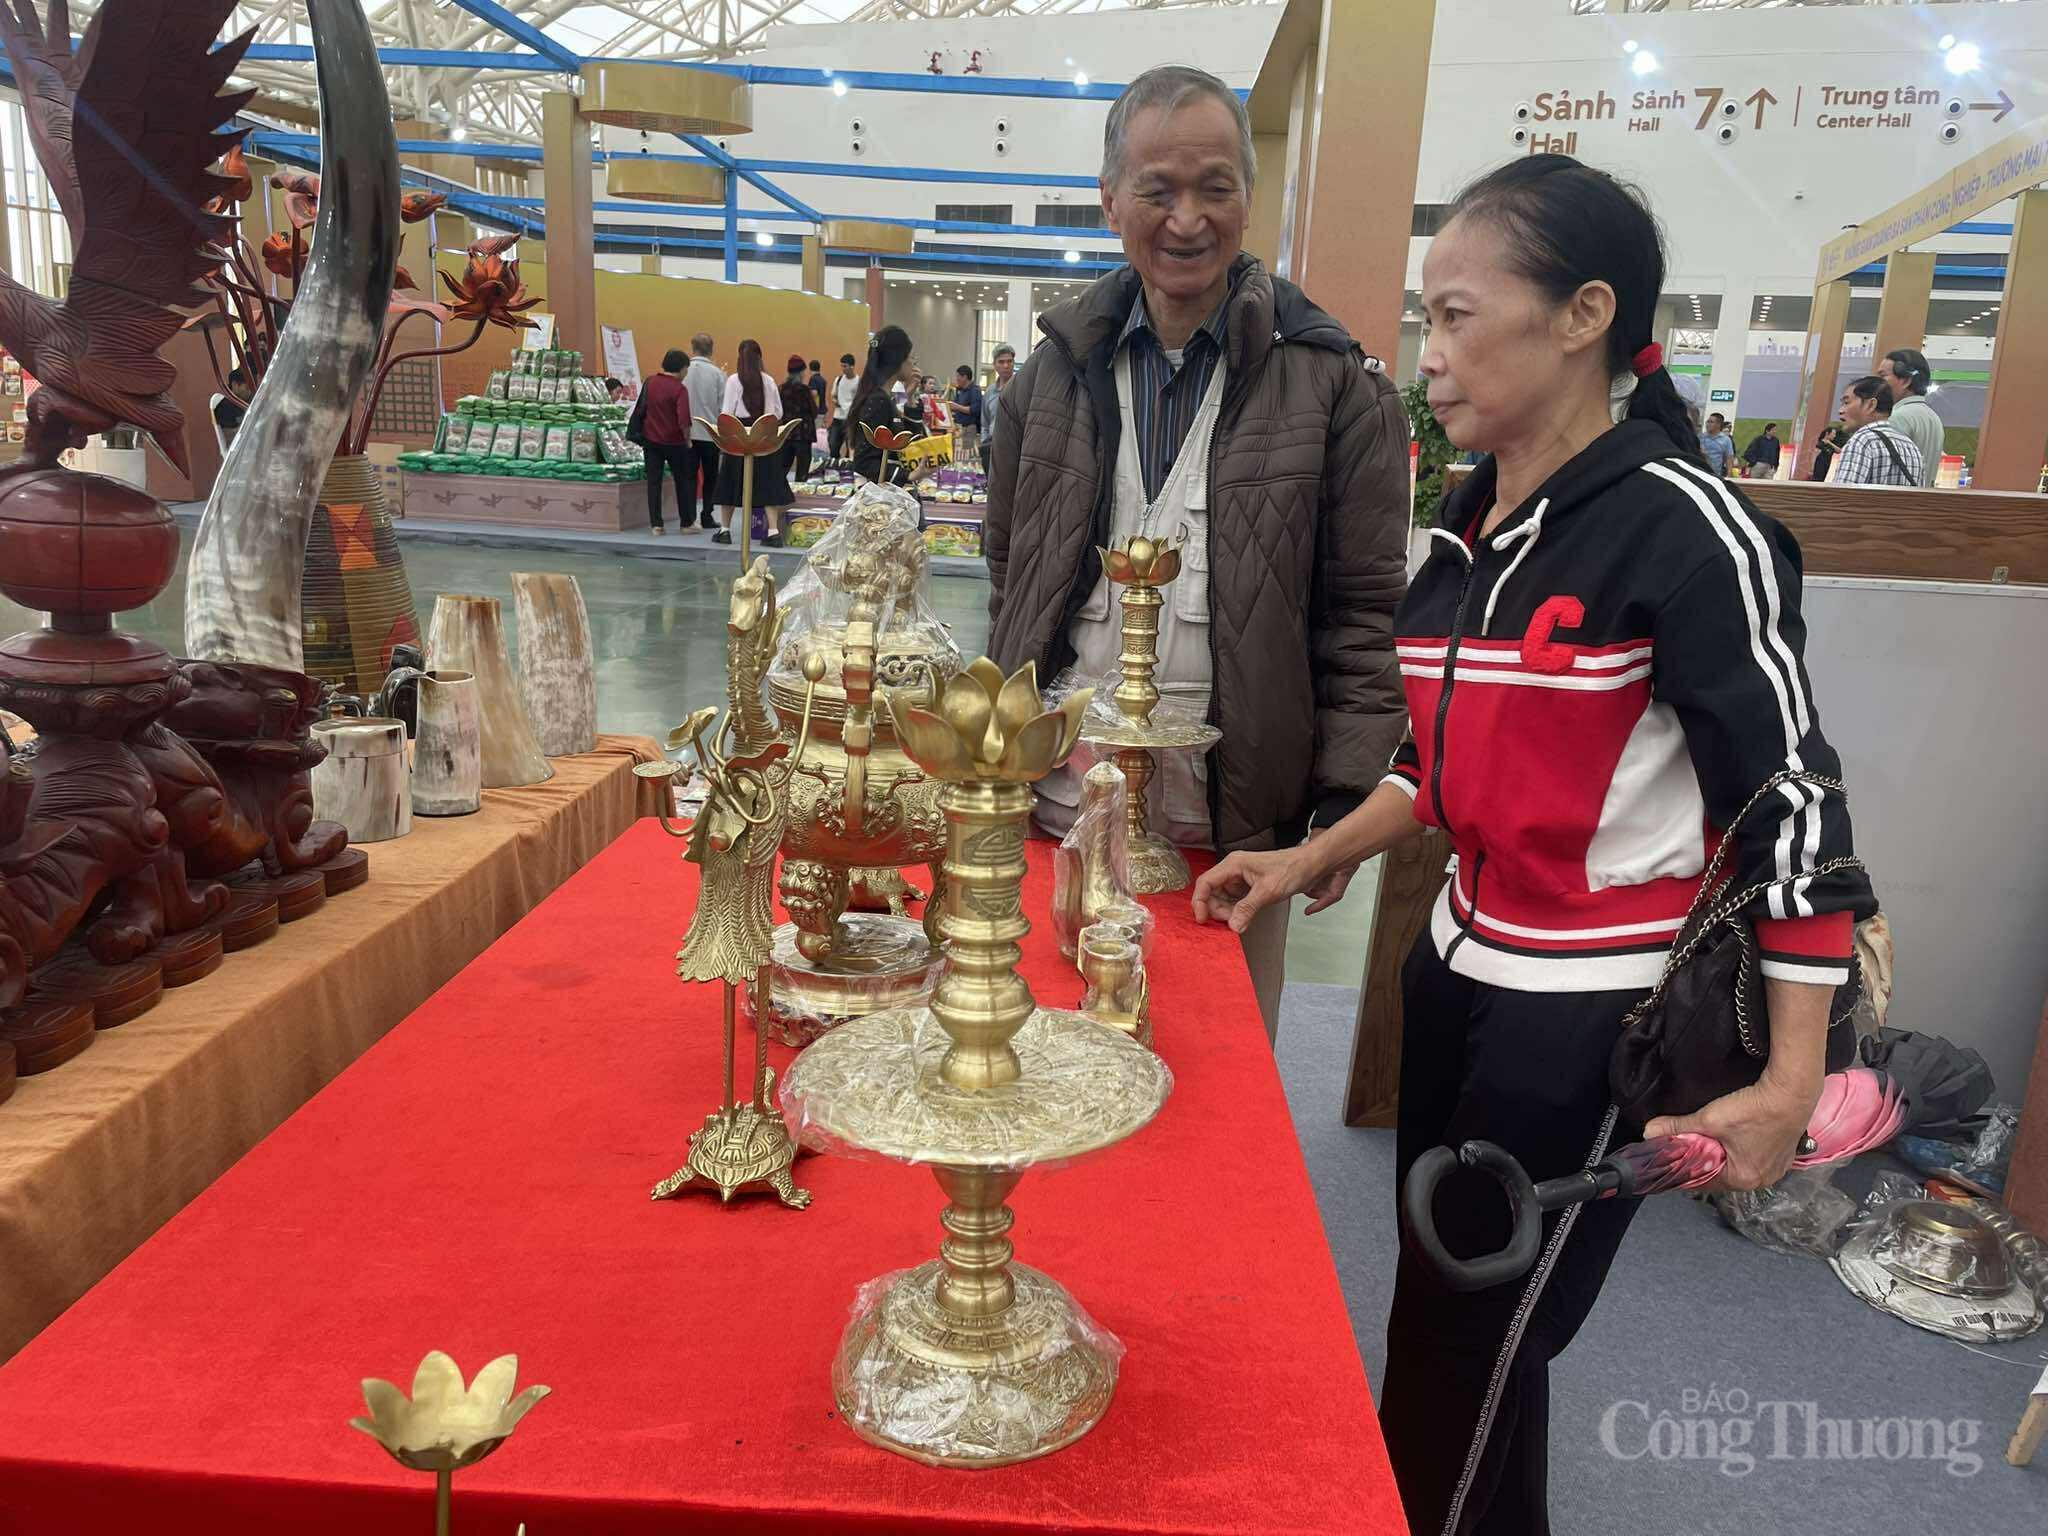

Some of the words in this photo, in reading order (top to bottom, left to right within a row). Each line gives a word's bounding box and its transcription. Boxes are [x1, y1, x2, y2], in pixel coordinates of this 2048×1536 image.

[1533, 90, 1616, 122] Sảnh
[1632, 89, 1685, 110] Sảnh
[1694, 87, 1724, 130] 7
[1821, 86, 1889, 110] Trung
[1894, 85, 1940, 105] tâm
[1628, 117, 1660, 132] Hall
[1816, 114, 1874, 129] Center
[1877, 113, 1912, 128] Hall
[1529, 131, 1578, 155] Hall
[1520, 595, 1586, 675] C
